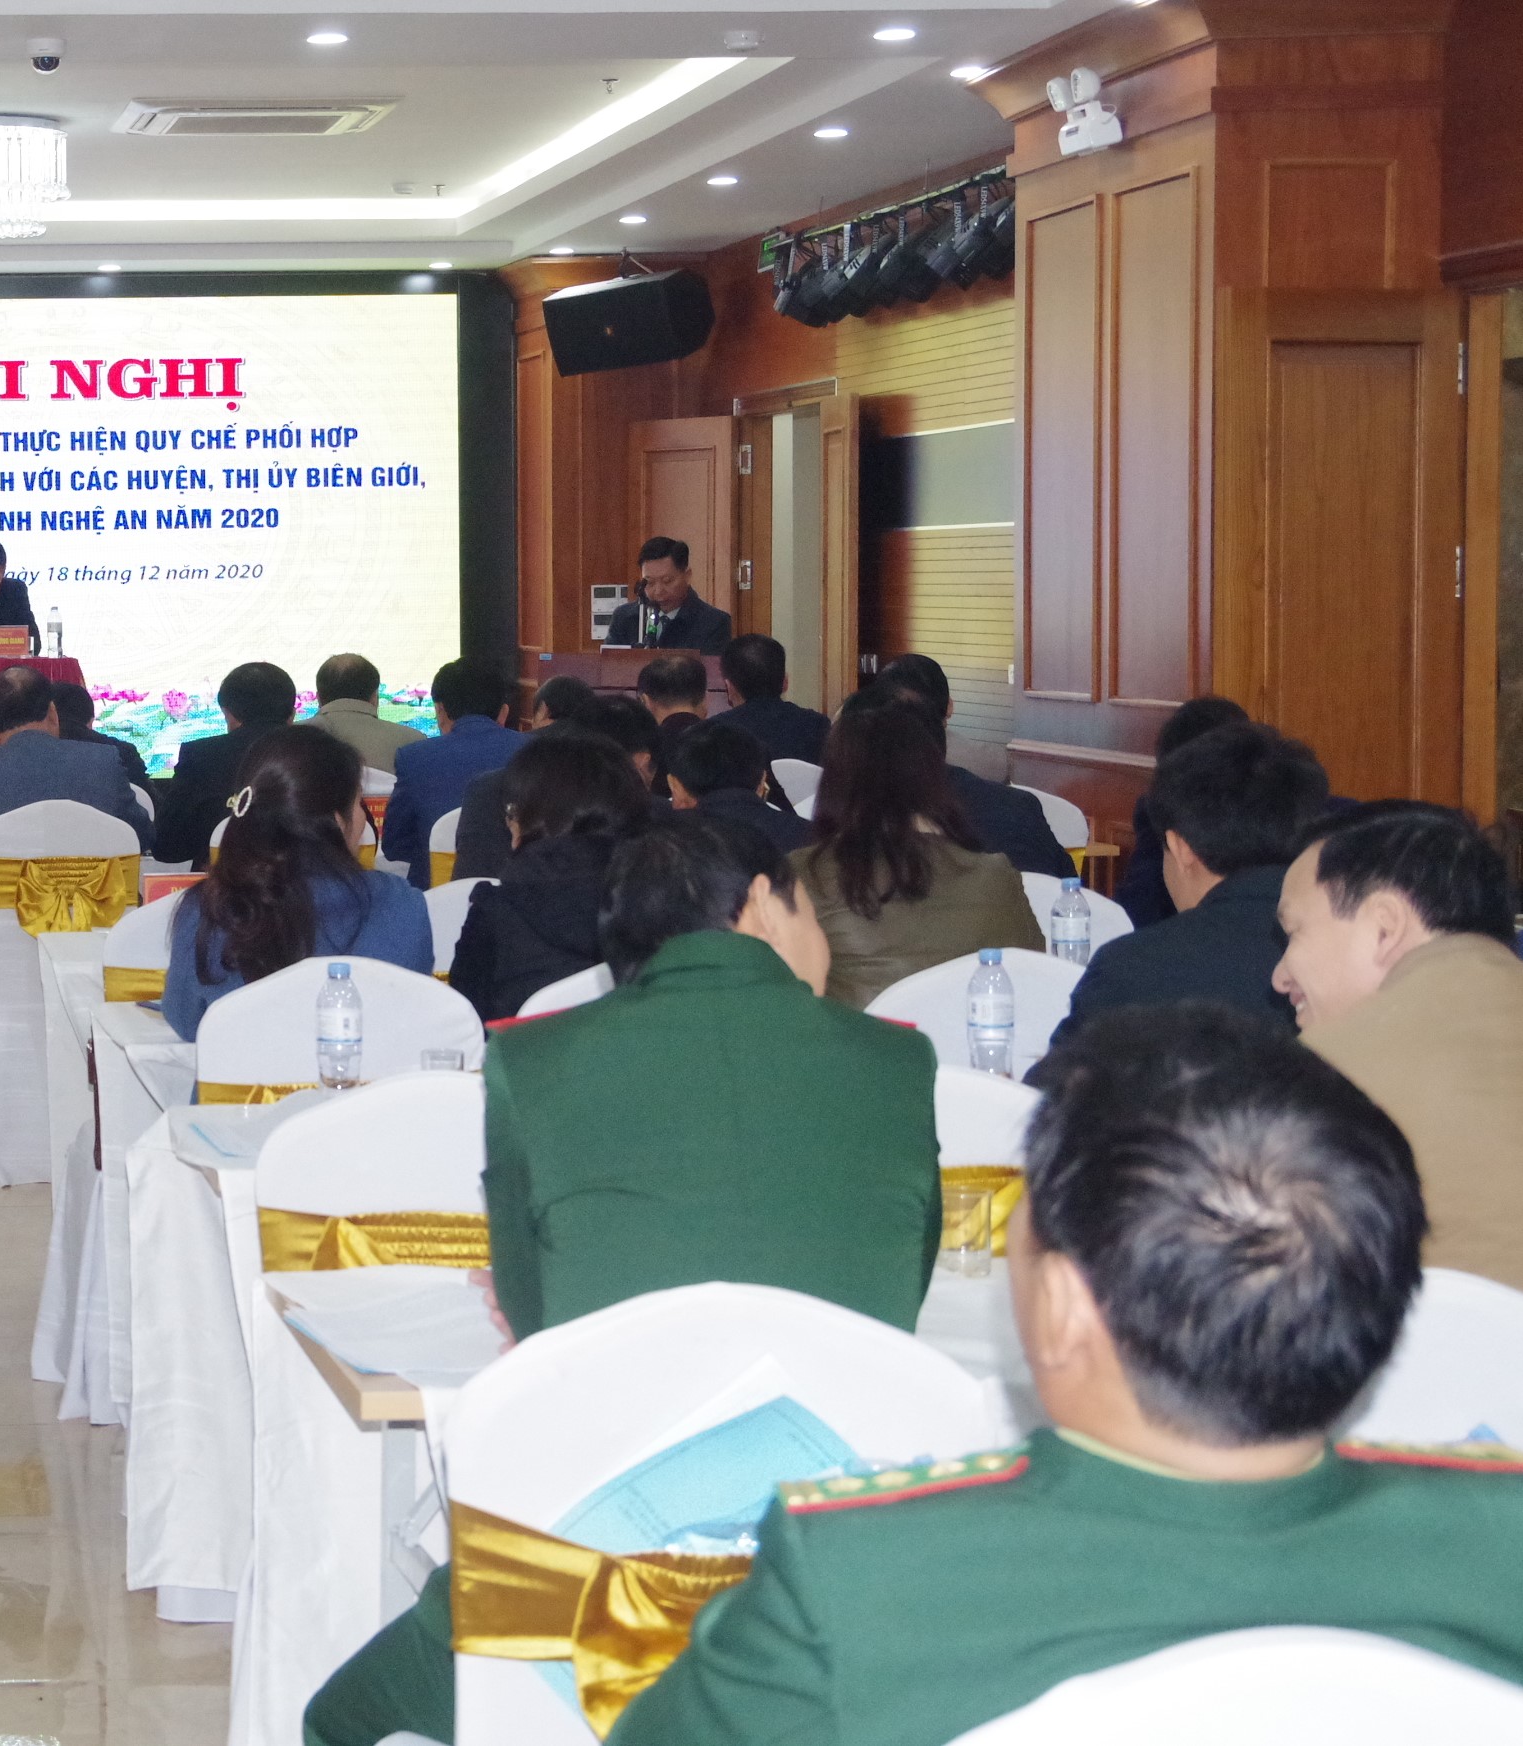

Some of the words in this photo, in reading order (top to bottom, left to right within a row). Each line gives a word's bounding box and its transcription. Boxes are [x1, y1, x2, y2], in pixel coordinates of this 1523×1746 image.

[48, 357, 244, 412] NGHỊ
[0, 430, 61, 456] THỰC
[70, 427, 127, 456] HIỆN
[135, 430, 182, 453] QUY
[191, 422, 238, 450] CHẾ
[245, 421, 302, 449] PHỐI
[311, 426, 359, 453] HỢP
[23, 466, 62, 492] VỚI
[70, 466, 119, 492] CÁC
[127, 465, 214, 494] HUYỆN,
[222, 468, 260, 493] THỊ
[268, 461, 298, 488] ỦY
[307, 461, 363, 488] BIÊN
[371, 462, 426, 489] GIỚI,
[40, 506, 105, 534] NGHỆ
[114, 509, 147, 530] AN
[157, 505, 212, 529] NĂM
[221, 508, 279, 529] 2020
[48, 566, 69, 581] 18
[74, 565, 132, 585] tháng
[139, 565, 161, 580] 12
[166, 565, 209, 580] năm
[214, 563, 264, 579] 2020
